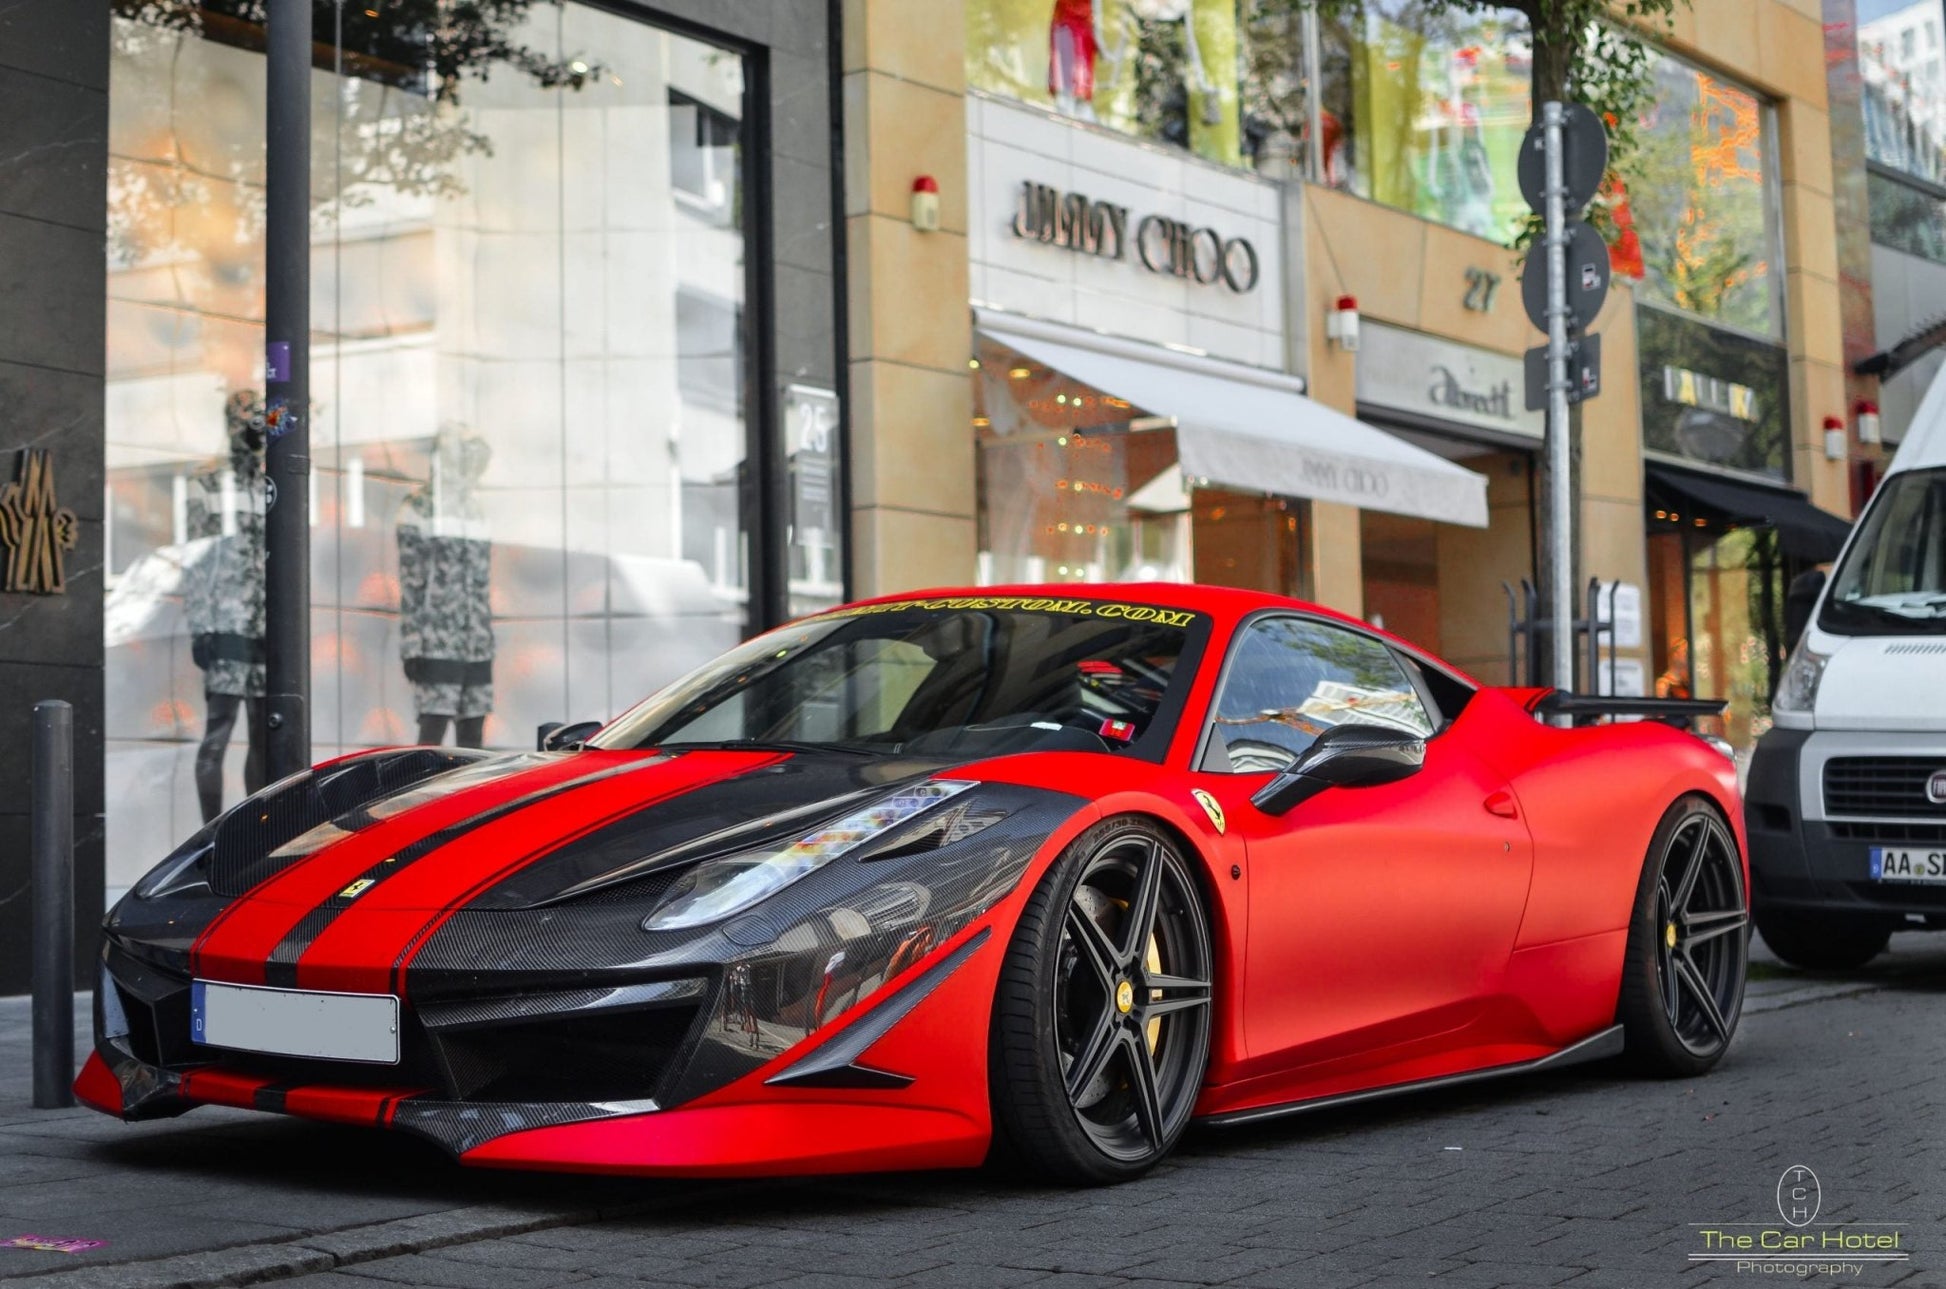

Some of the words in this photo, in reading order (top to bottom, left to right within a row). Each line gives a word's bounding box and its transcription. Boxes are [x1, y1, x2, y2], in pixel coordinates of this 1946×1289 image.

[1137, 214, 1259, 293] CHOO
[1463, 266, 1501, 313] 27
[800, 404, 828, 453] 25
[1883, 852, 1911, 875] AA
